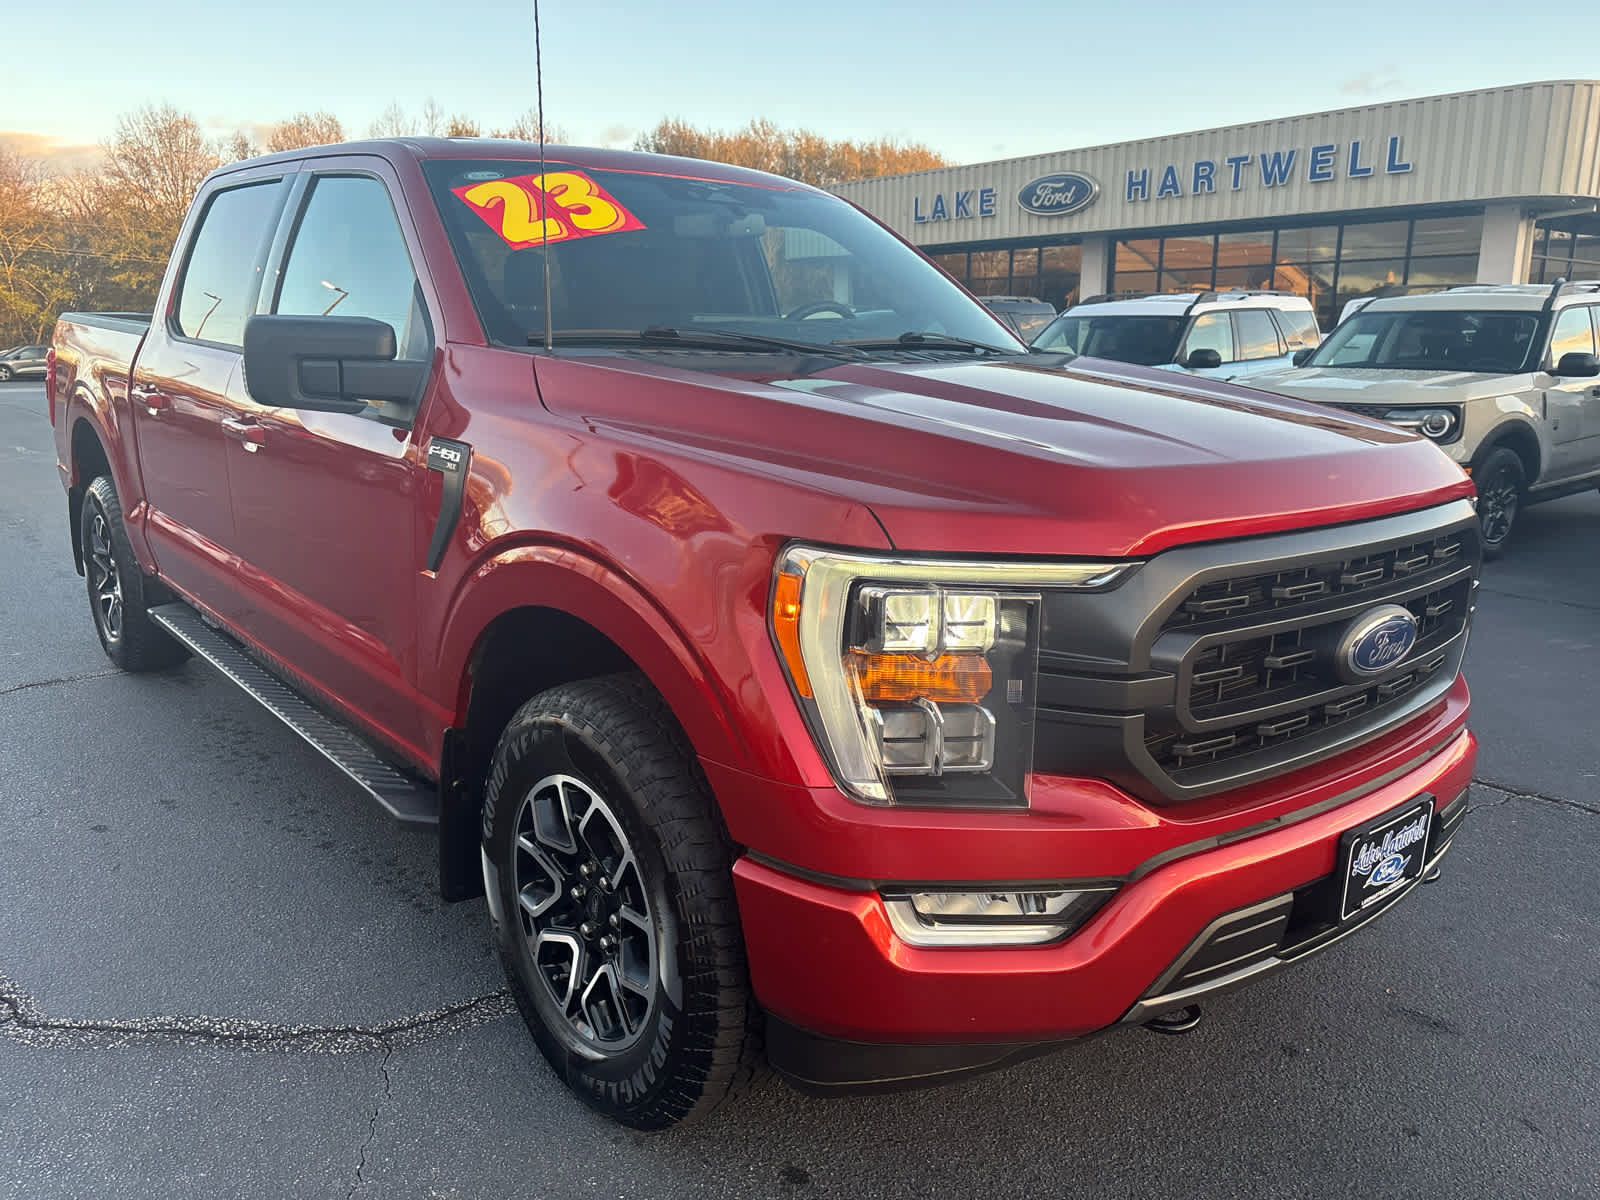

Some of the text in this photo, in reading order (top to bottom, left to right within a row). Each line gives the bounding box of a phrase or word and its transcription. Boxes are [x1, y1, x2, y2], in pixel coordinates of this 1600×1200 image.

[912, 136, 1413, 223] LAKE Ford HARTWELL
[464, 172, 626, 243] 23
[428, 445, 461, 462] F-150
[1368, 627, 1408, 665] Ford
[1352, 841, 1384, 877] Lake
